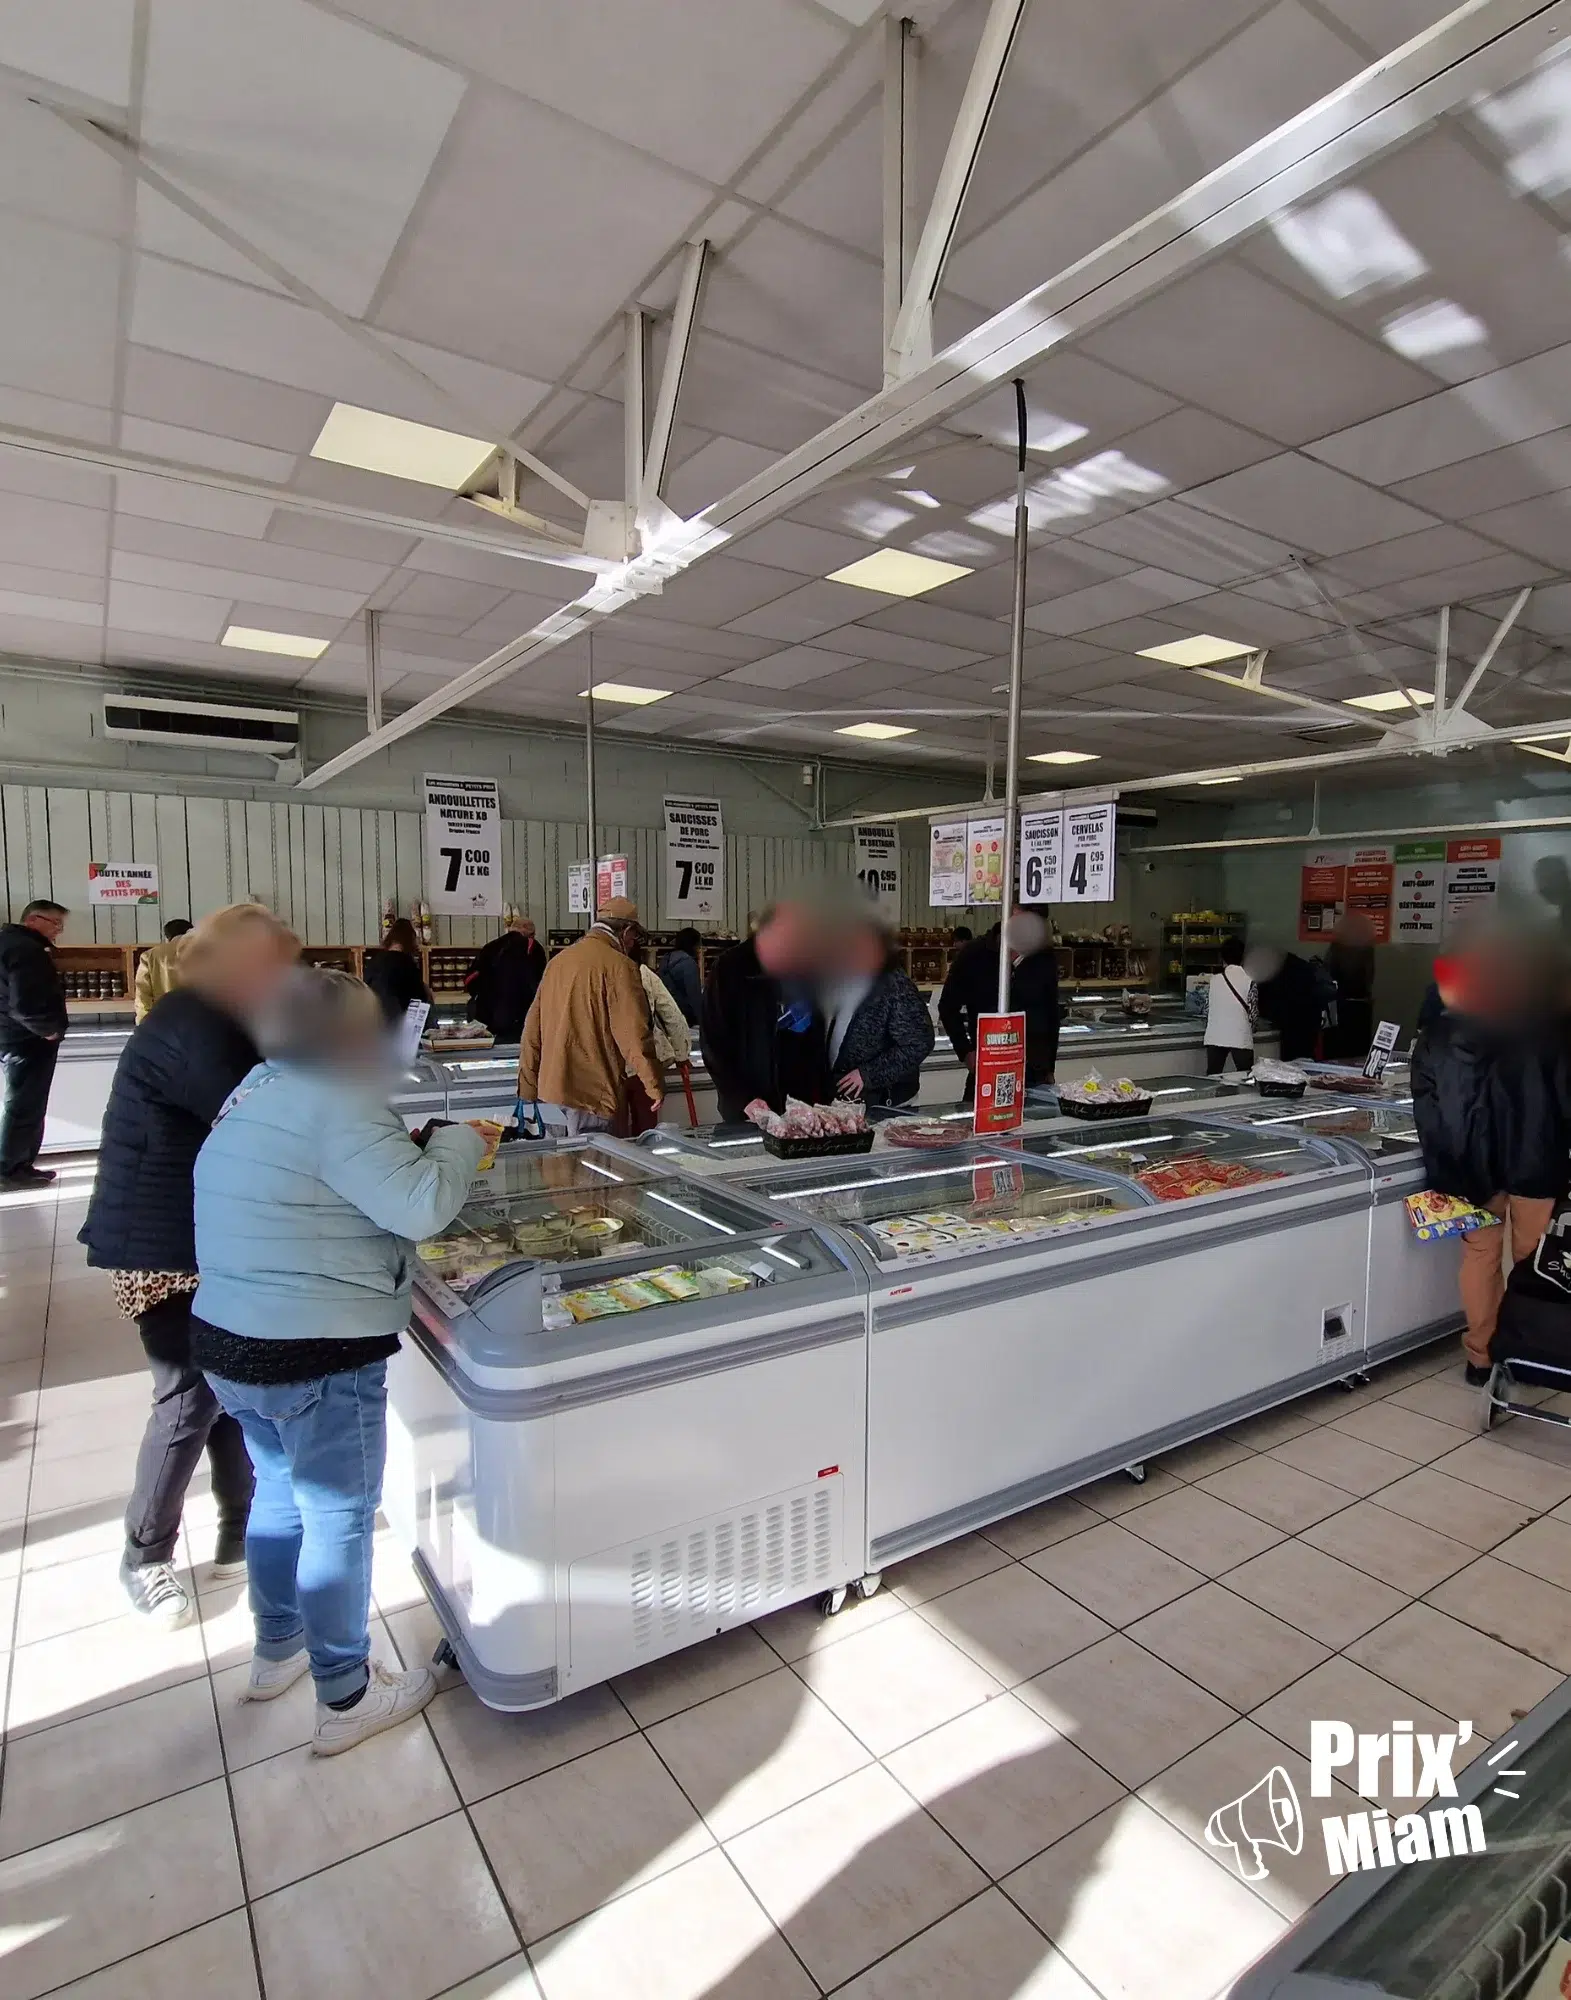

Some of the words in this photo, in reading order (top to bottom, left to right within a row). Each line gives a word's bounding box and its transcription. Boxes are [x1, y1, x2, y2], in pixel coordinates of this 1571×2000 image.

[428, 793, 496, 809] ANDOUILLETTES
[440, 808, 474, 820] NATURE
[669, 812, 718, 826] SAUCISSES
[680, 826, 689, 836] DE
[690, 827, 710, 837] PORC
[1025, 827, 1059, 840] SAUCISSON
[1071, 822, 1104, 836] CERVELAS
[95, 869, 120, 878] TOUTE
[121, 868, 153, 879] L'ANNÉE
[440, 847, 463, 892] 7
[465, 849, 490, 864] €00
[465, 865, 475, 876] LE
[477, 866, 490, 876] KG
[1026, 856, 1043, 897] 6
[1044, 854, 1057, 866] €50
[1069, 852, 1088, 895] 4
[1090, 851, 1105, 862] €95
[115, 880, 131, 888] DES
[675, 860, 693, 900] 7
[694, 862, 715, 875] €00
[694, 876, 703, 886] LE
[100, 888, 128, 897] PETITS
